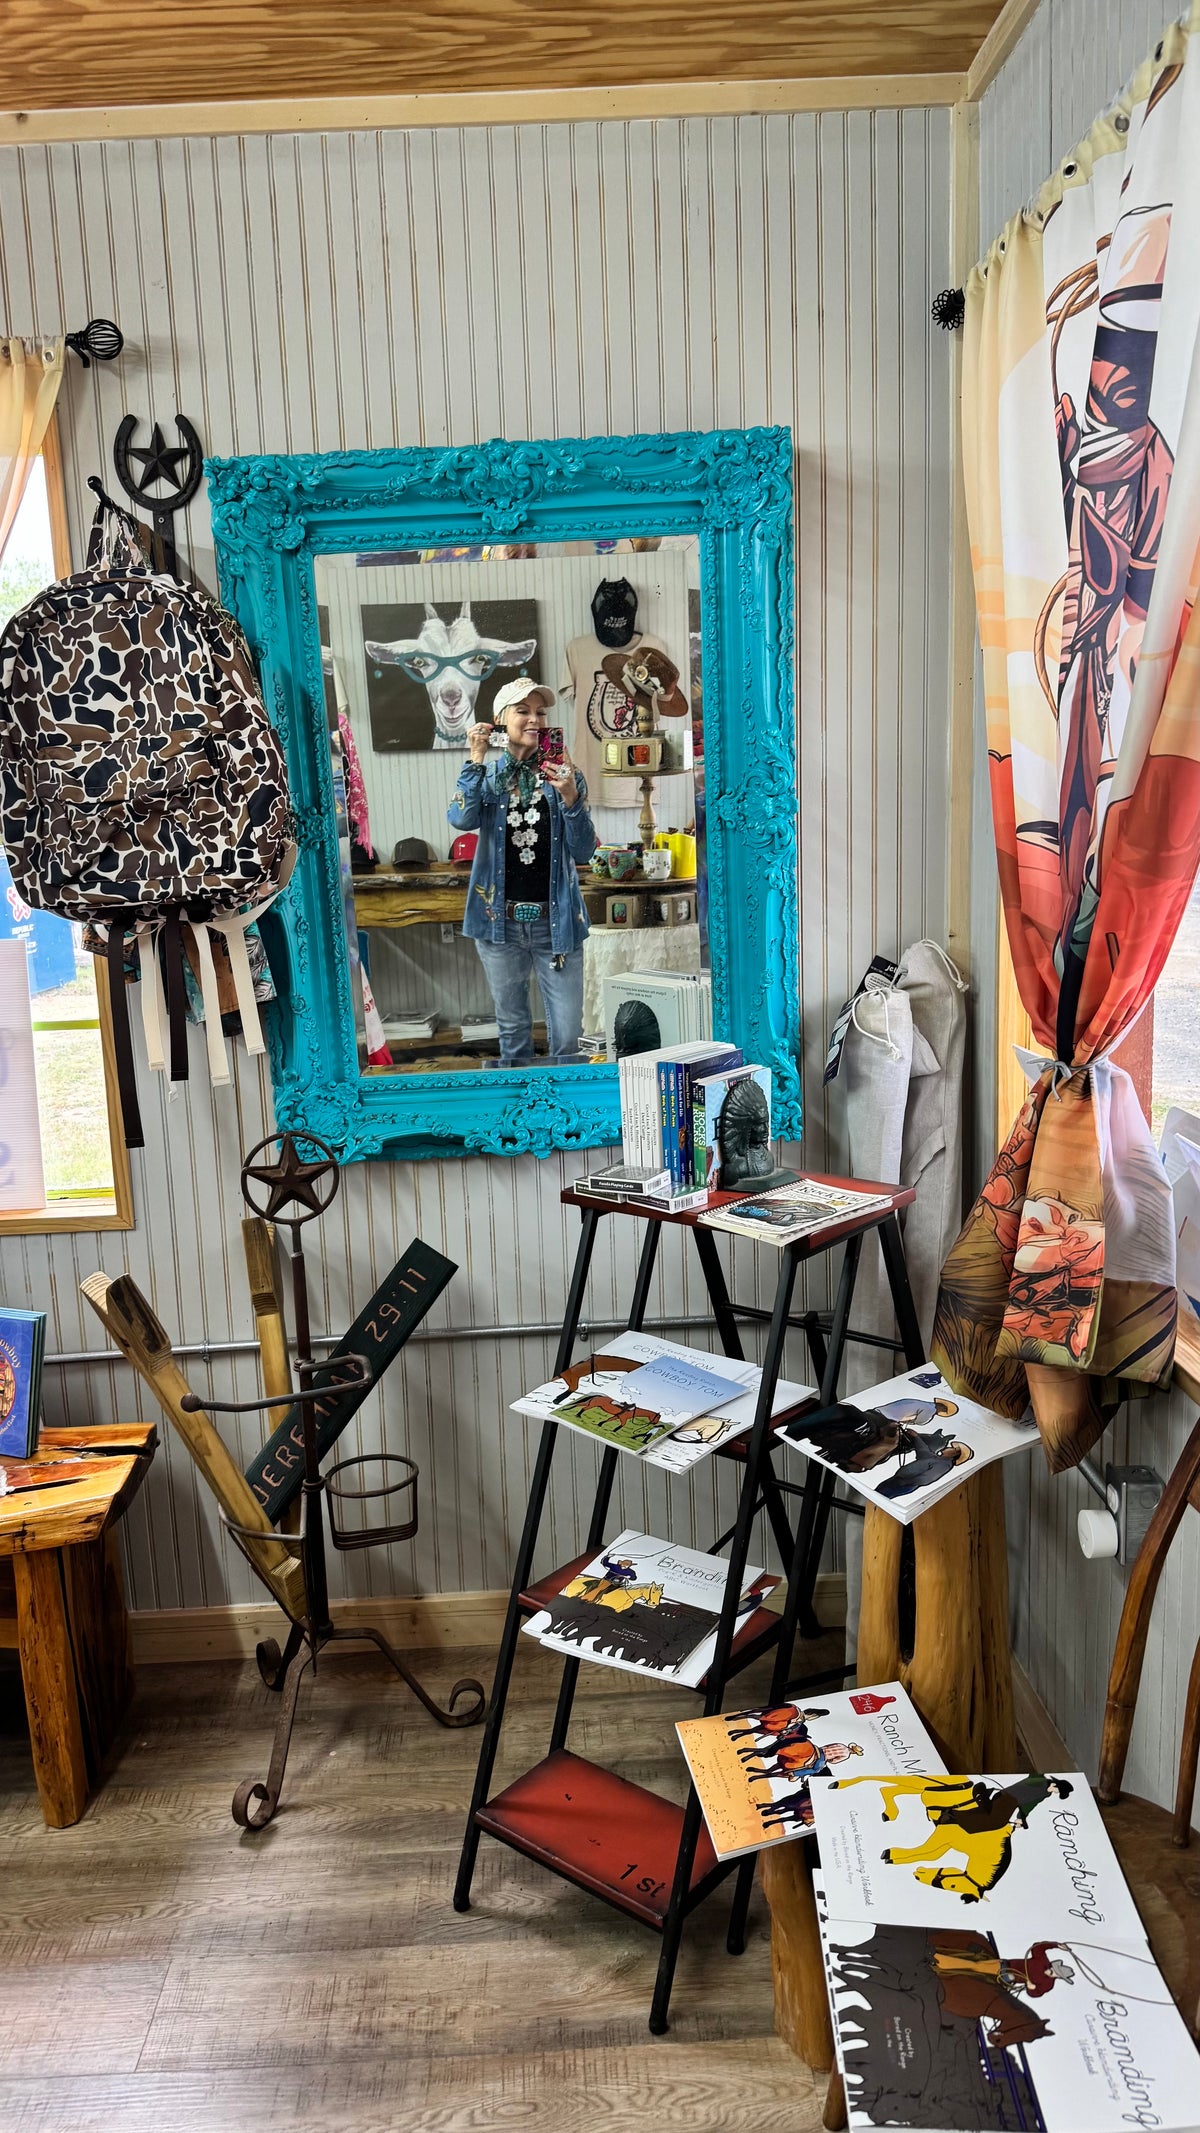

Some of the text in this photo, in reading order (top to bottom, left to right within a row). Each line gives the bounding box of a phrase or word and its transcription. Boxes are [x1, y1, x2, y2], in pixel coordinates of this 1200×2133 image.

[698, 1111, 706, 1146] ROCKS
[364, 1267, 427, 1343] 29:11
[0, 1338, 21, 1368] owboy
[645, 1366, 697, 1386] COWBOY
[697, 1385, 725, 1398] TOM
[877, 1713, 909, 1756] Ranch
[1049, 1809, 1106, 1926] Ranching
[1096, 1998, 1164, 2131] Branding
